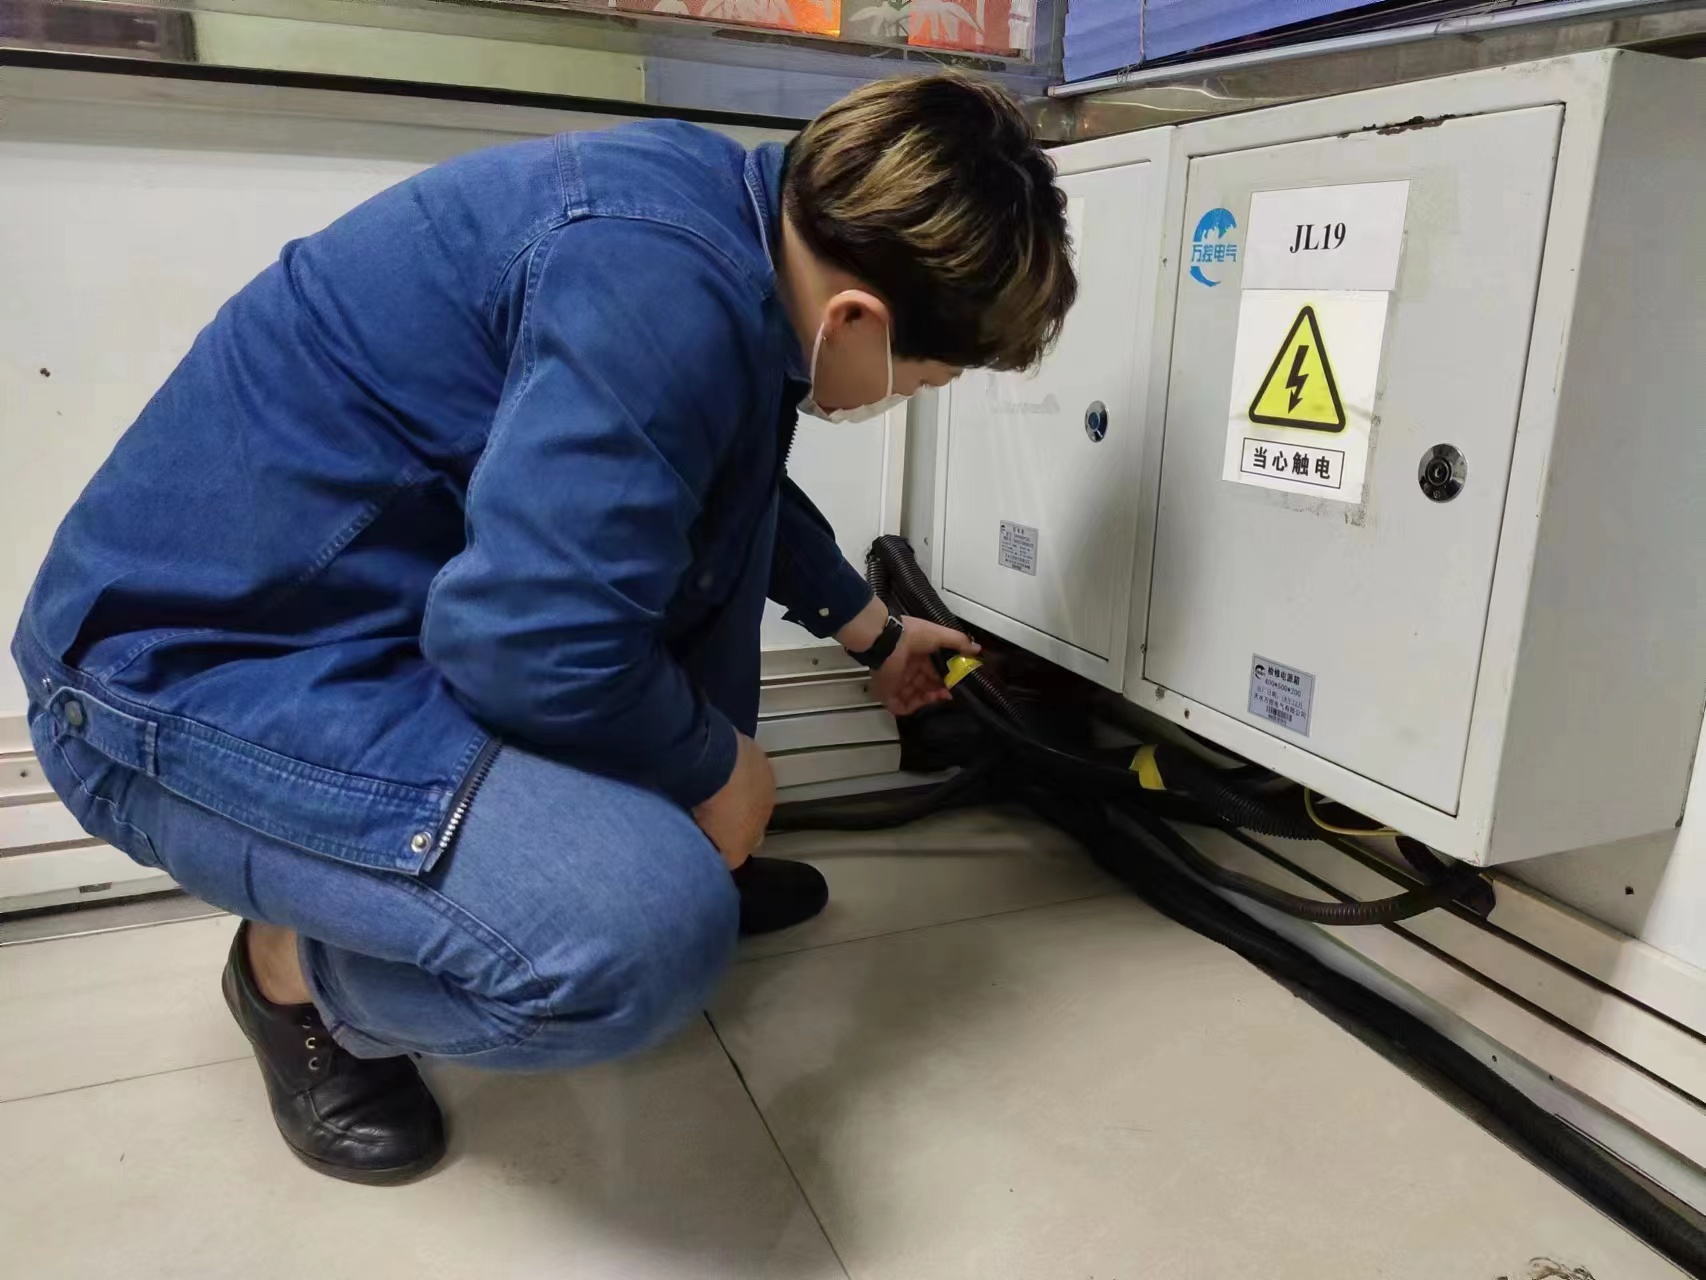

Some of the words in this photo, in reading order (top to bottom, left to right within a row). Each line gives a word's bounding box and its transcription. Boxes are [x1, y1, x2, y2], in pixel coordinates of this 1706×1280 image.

[1191, 244, 1237, 262] 万控电气
[1289, 222, 1346, 254] JL19
[1253, 446, 1331, 479] 当心触电
